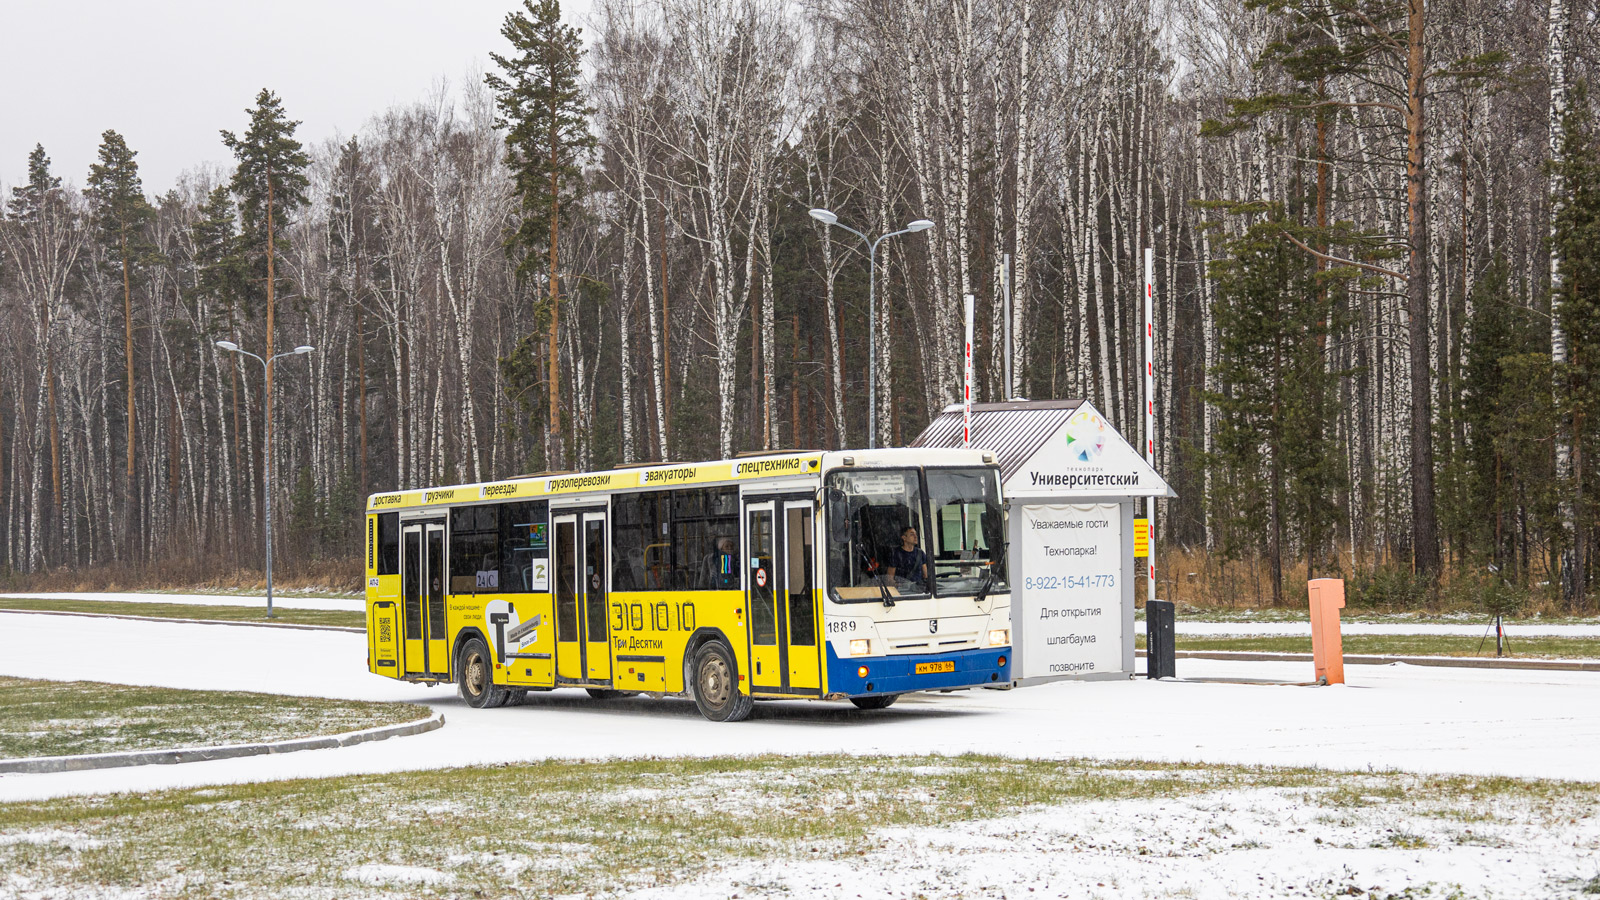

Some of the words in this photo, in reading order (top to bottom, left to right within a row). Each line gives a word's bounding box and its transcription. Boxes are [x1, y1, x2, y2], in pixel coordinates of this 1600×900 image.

[736, 457, 800, 475] спецтехника
[645, 466, 697, 483] эвакуаторы
[1030, 471, 1139, 488] Университетский
[483, 483, 518, 496] переезды
[548, 475, 611, 491] грузоперевозки
[373, 494, 402, 507] доставка
[424, 490, 455, 503] грузчики
[1031, 519, 1083, 530] Уважаемые
[1086, 519, 1109, 529] гости
[1044, 545, 1097, 558] Технопарка!
[1025, 574, 1115, 590] 8-922-15-41-773
[612, 602, 643, 631] 310
[650, 602, 669, 631] 10
[676, 602, 696, 631] 10
[1040, 608, 1059, 619] Для
[1061, 607, 1102, 619] открытия
[827, 620, 857, 633] 1889
[612, 636, 627, 651] Три
[629, 636, 663, 651] Десятки
[1047, 633, 1096, 646] шлагбаума
[930, 663, 942, 671] 978
[1050, 661, 1095, 673] позвоните
